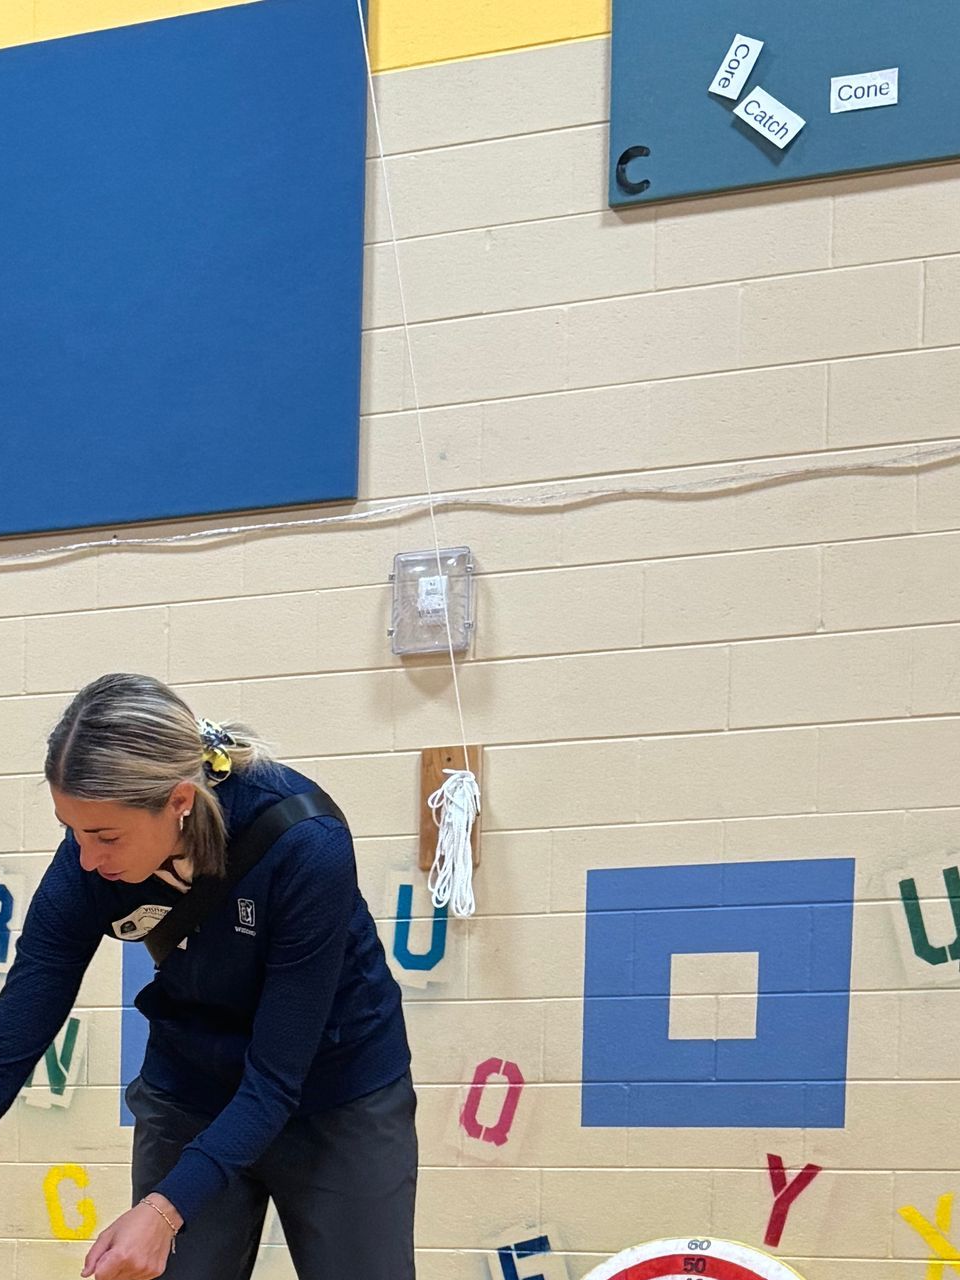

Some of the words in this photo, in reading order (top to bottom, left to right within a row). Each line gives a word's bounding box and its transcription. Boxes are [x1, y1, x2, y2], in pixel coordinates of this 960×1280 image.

[717, 43, 751, 90] Core
[837, 80, 891, 102] Cone
[743, 99, 790, 141] Catch
[615, 145, 651, 195] C
[393, 883, 450, 971] U
[764, 1153, 822, 1247] Y
[683, 1257, 706, 1273] 50
[687, 1239, 711, 1251] 60
